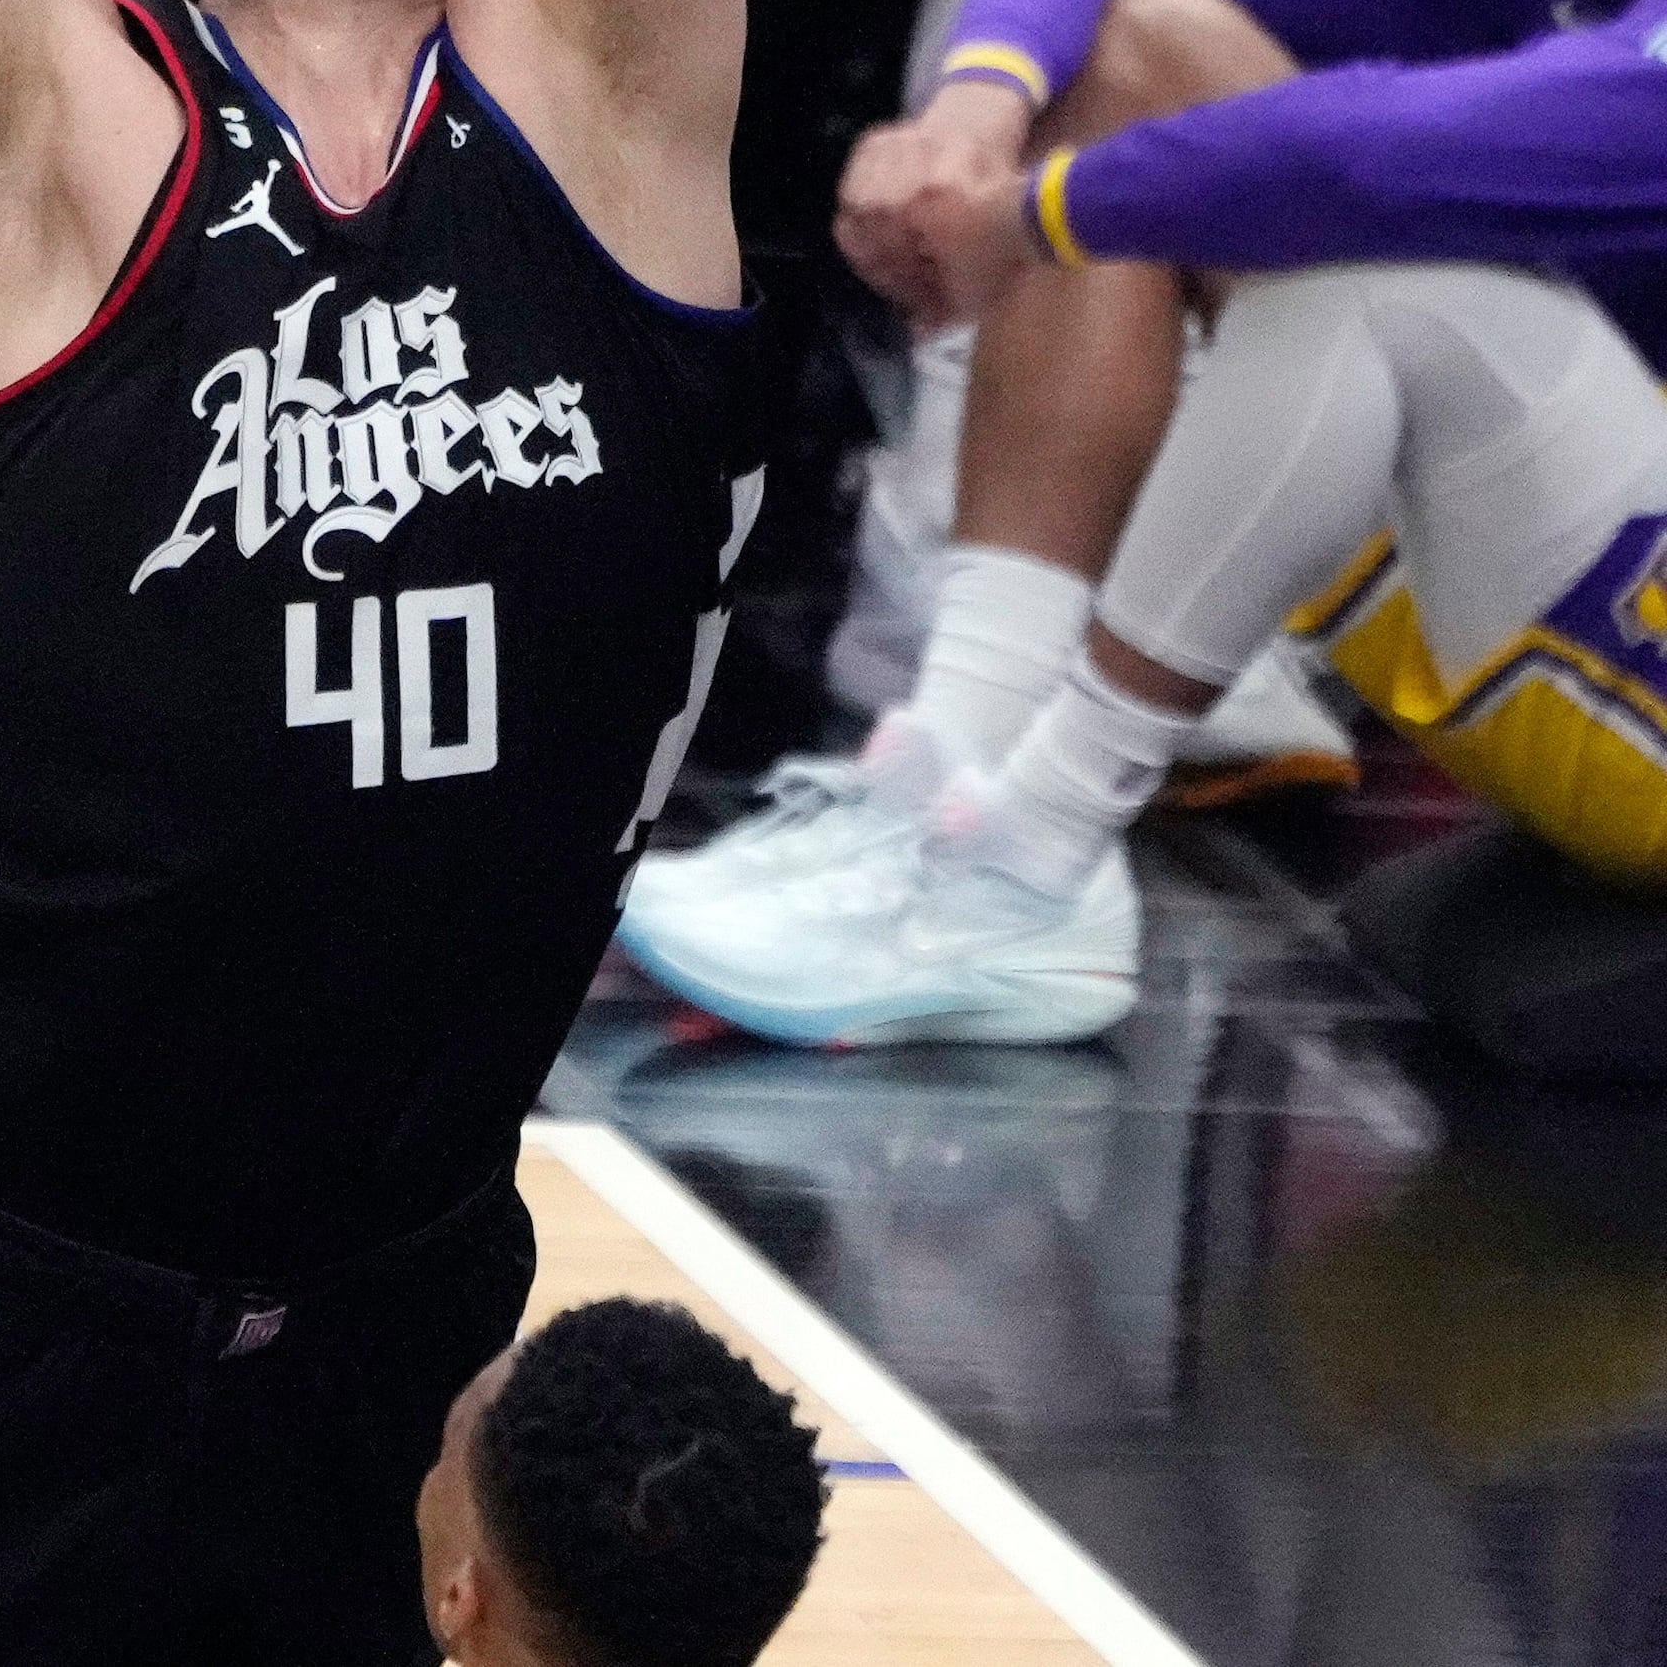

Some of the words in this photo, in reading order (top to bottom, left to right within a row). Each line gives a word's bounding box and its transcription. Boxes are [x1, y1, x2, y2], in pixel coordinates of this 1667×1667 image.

[270, 276, 469, 407] Los
[129, 346, 604, 596] Angees
[284, 580, 499, 790] 40
